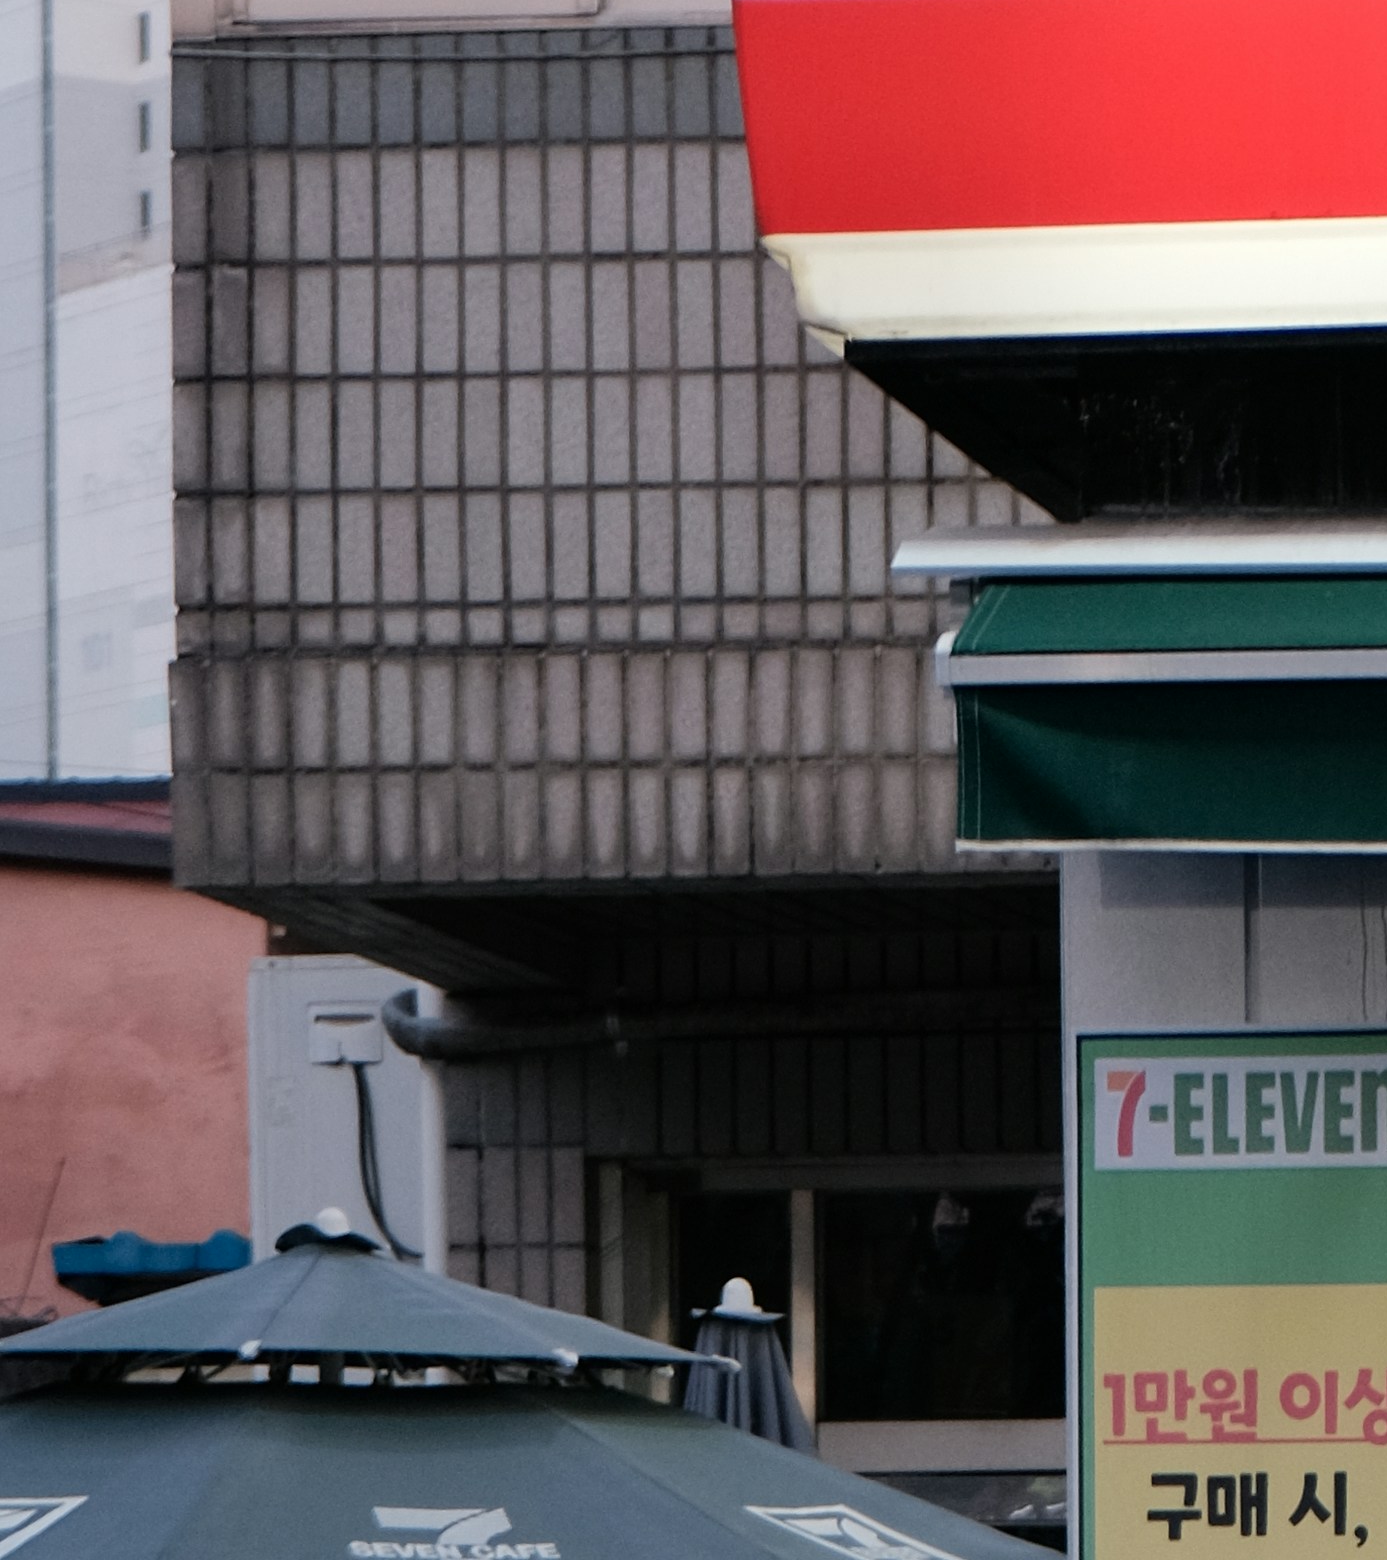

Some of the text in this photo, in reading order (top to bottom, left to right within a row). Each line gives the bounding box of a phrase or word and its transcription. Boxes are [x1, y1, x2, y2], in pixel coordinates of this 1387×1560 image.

[1102, 1368, 1259, 1442] 1만원
[1146, 1470, 1370, 1548] 구매 시,
[348, 1540, 562, 1559] SEVEN CAFE
